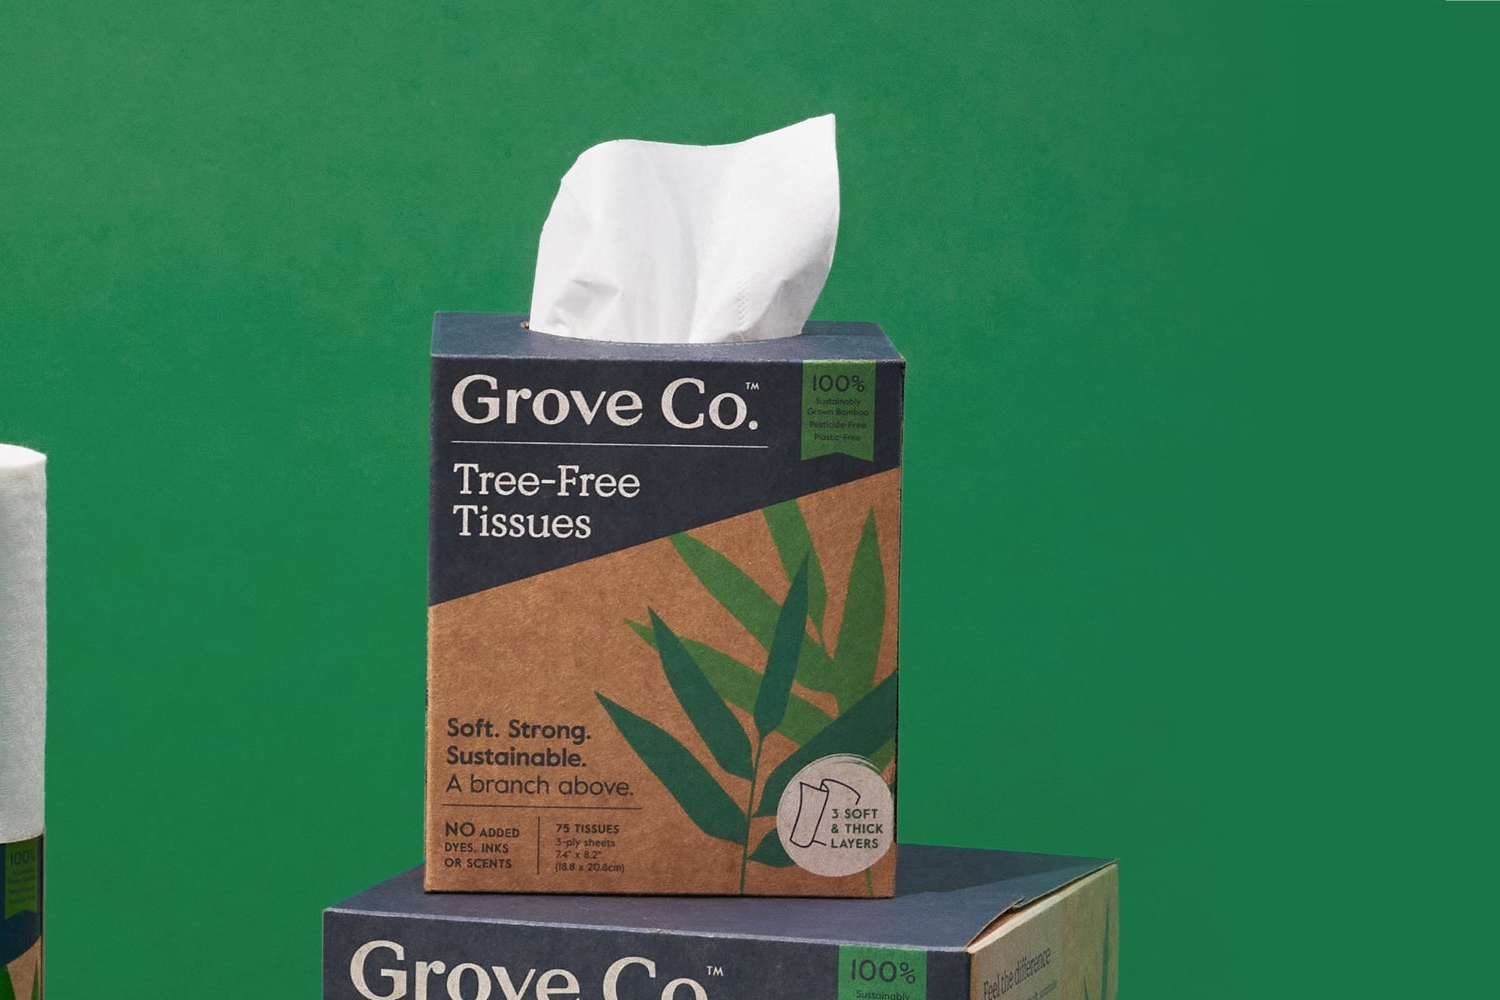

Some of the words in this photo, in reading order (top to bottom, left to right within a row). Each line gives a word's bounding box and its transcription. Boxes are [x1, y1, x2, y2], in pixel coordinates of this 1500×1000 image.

[812, 374, 865, 392] 100%
[452, 374, 643, 426] Grove
[453, 463, 640, 498] Tree-Free
[453, 504, 591, 539] Tissues
[447, 717, 500, 738] Soft.
[508, 719, 591, 745] Strong.
[446, 745, 587, 767] Sustainable.
[446, 774, 463, 793] A
[470, 774, 549, 794] branch
[558, 775, 634, 796] above.
[831, 809, 839, 819] 3
[844, 809, 878, 819] SOFT
[445, 822, 476, 837] NO
[479, 828, 520, 838] ADDED
[556, 824, 570, 833] 75
[574, 824, 620, 834] TISSUES
[831, 823, 839, 834] &
[845, 823, 884, 834] THICK
[445, 842, 477, 853] DYES,
[482, 843, 509, 854] INKS
[555, 838, 580, 848] 3-ply
[584, 839, 615, 847] sheets
[831, 838, 879, 849] LAYERS
[445, 858, 462, 868] OR
[466, 858, 512, 869] SCENTS
[851, 959, 916, 984] 100%
